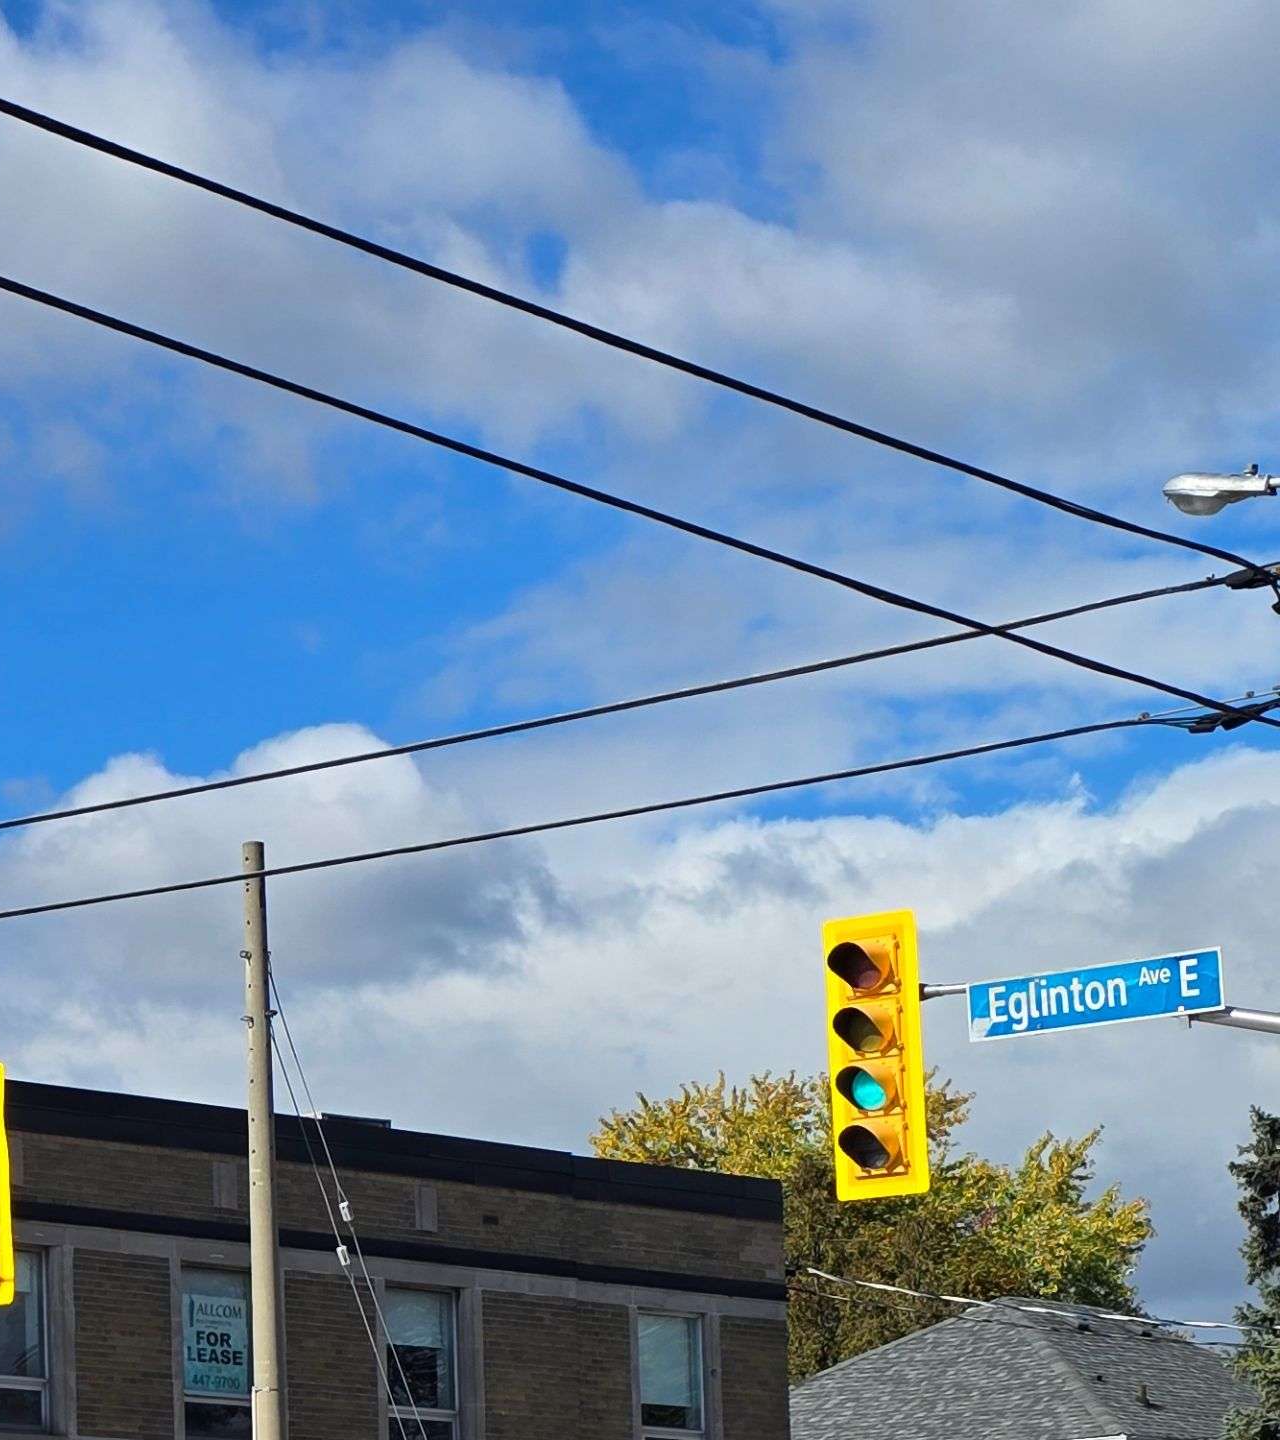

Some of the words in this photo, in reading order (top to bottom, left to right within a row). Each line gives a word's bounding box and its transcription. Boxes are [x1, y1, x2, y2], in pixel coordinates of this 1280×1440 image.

[988, 975, 1128, 1032] Eglinton
[1138, 966, 1171, 987] Ave
[1180, 957, 1201, 998] E
[196, 1302, 242, 1319] ALLCOM
[196, 1330, 232, 1348] FOR
[186, 1345, 244, 1366] LEASE
[191, 1374, 241, 1390] 447-9700
